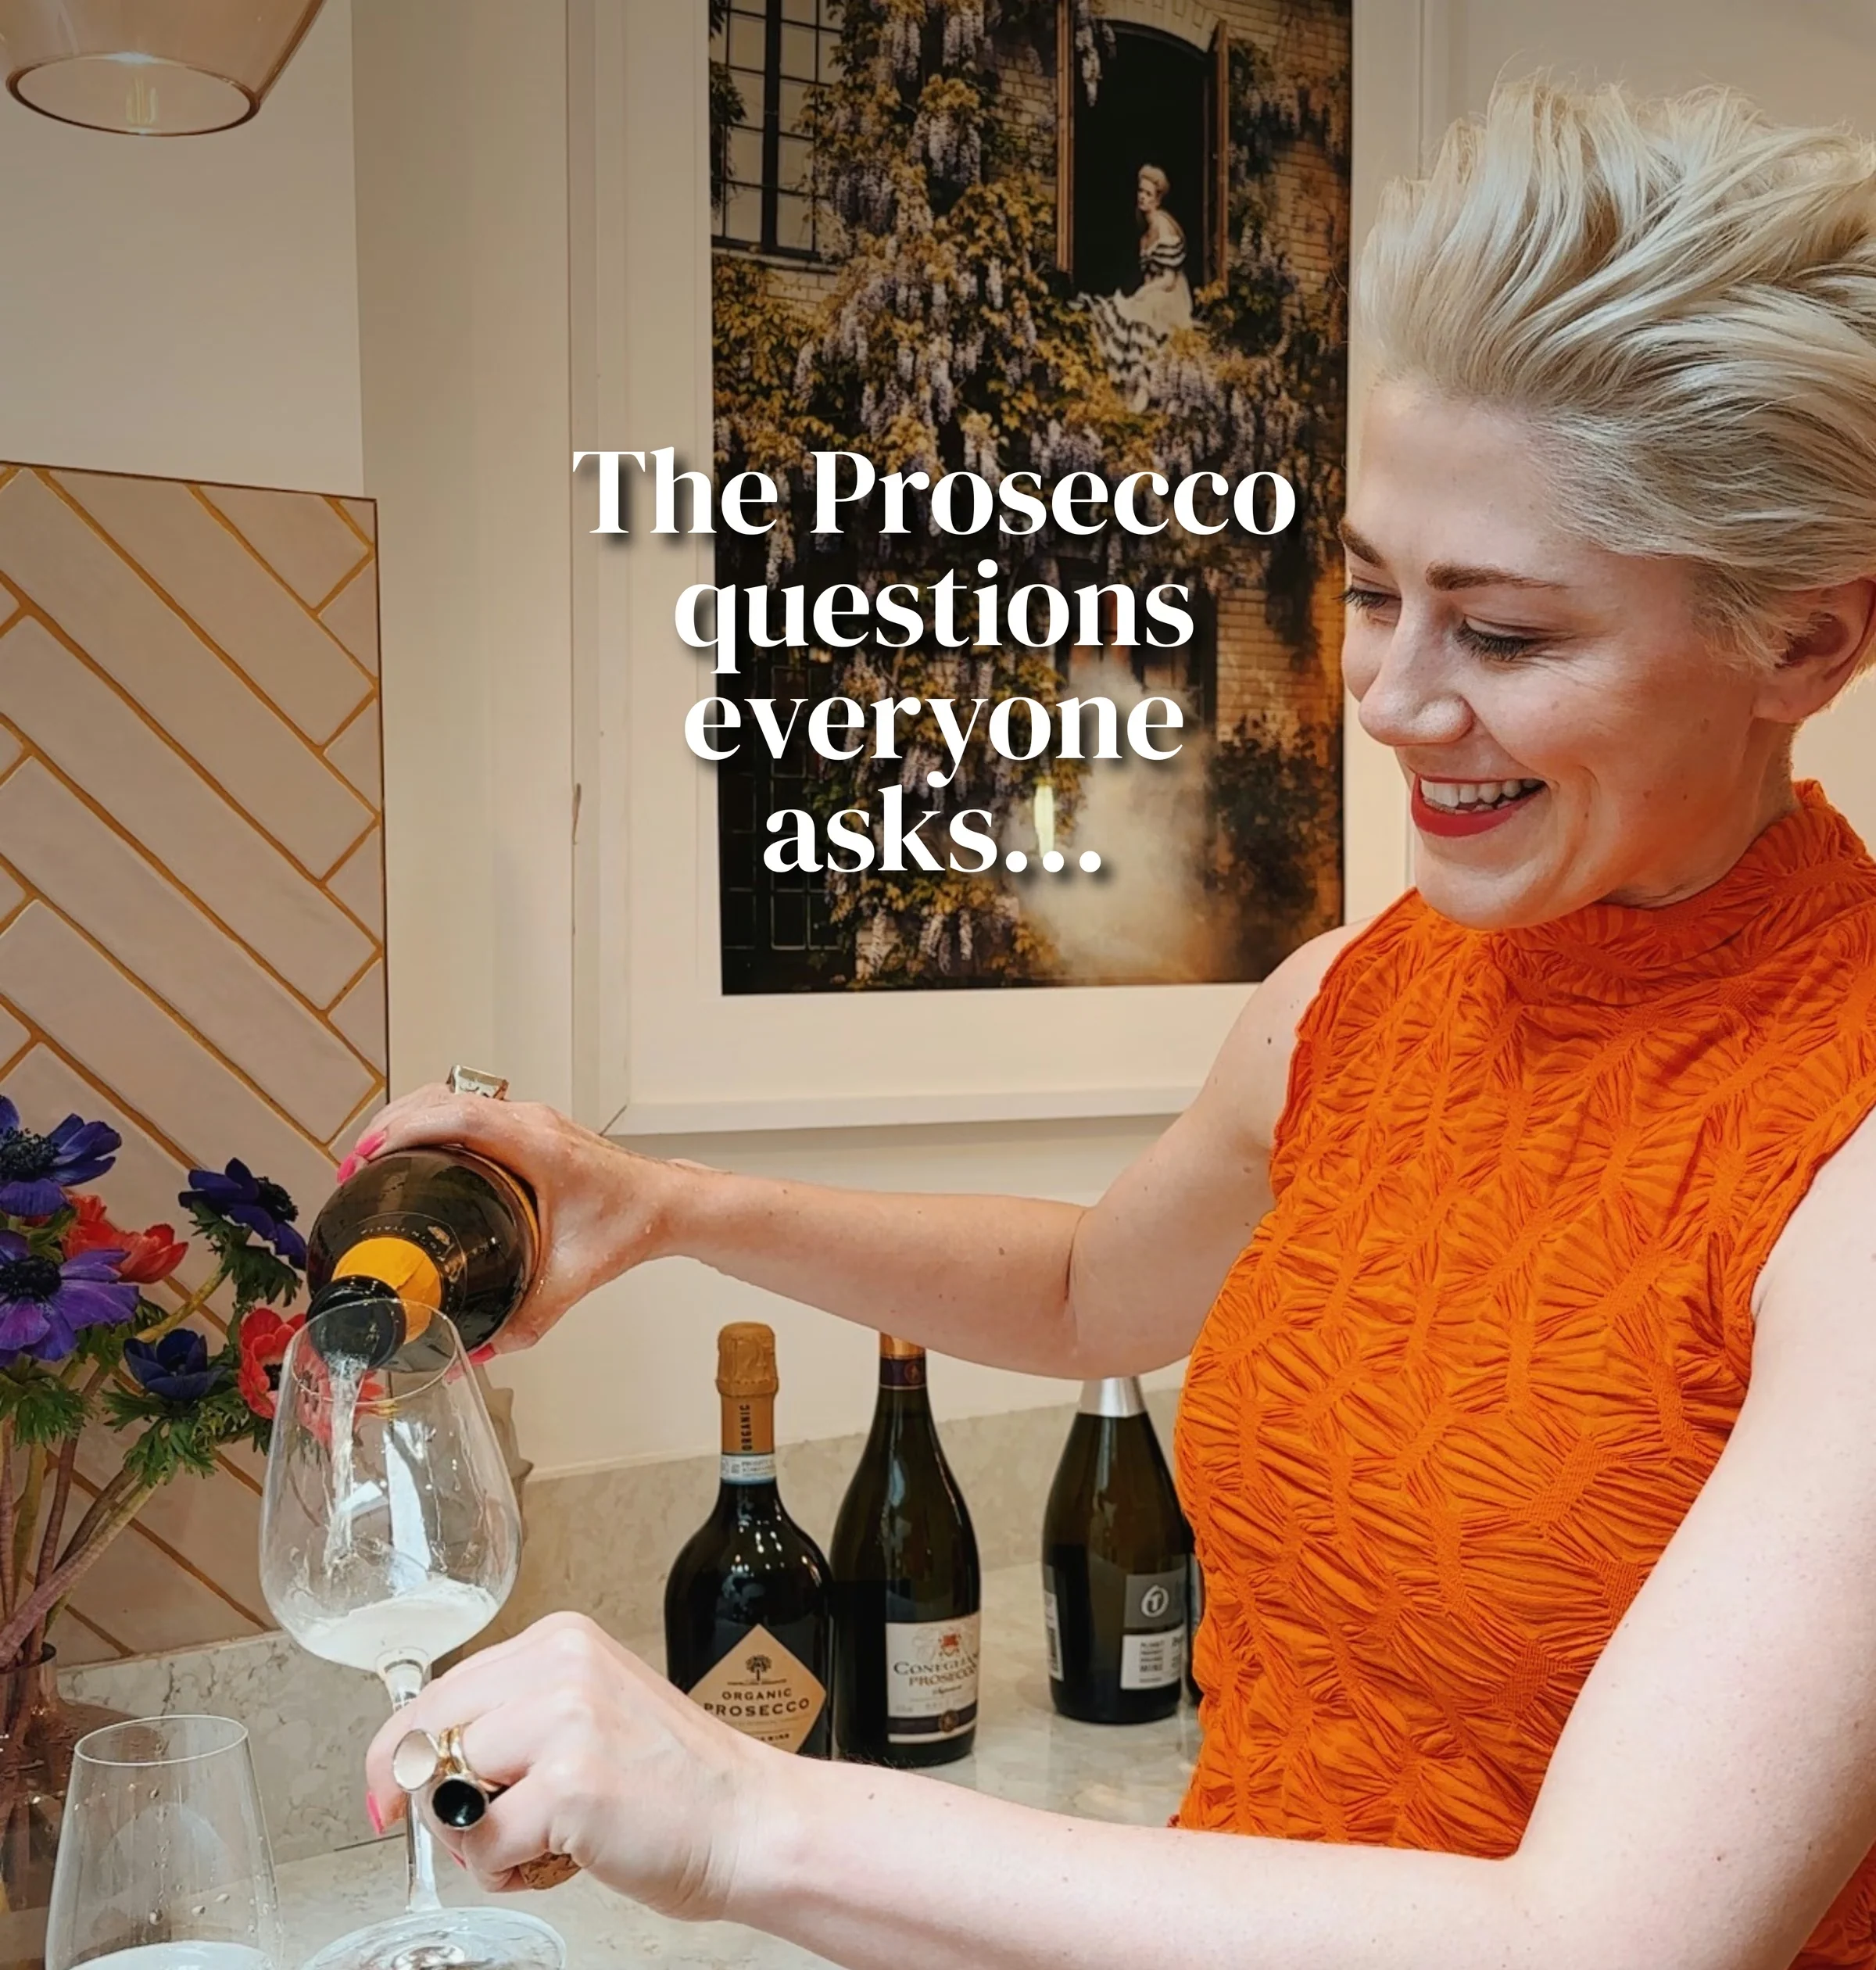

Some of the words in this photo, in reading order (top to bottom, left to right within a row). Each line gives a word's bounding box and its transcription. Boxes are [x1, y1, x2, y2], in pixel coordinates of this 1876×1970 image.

[739, 1404, 753, 1452] ORGANIC
[721, 1688, 792, 1701] ORGANIC
[704, 1697, 810, 1717] PROSECCO
